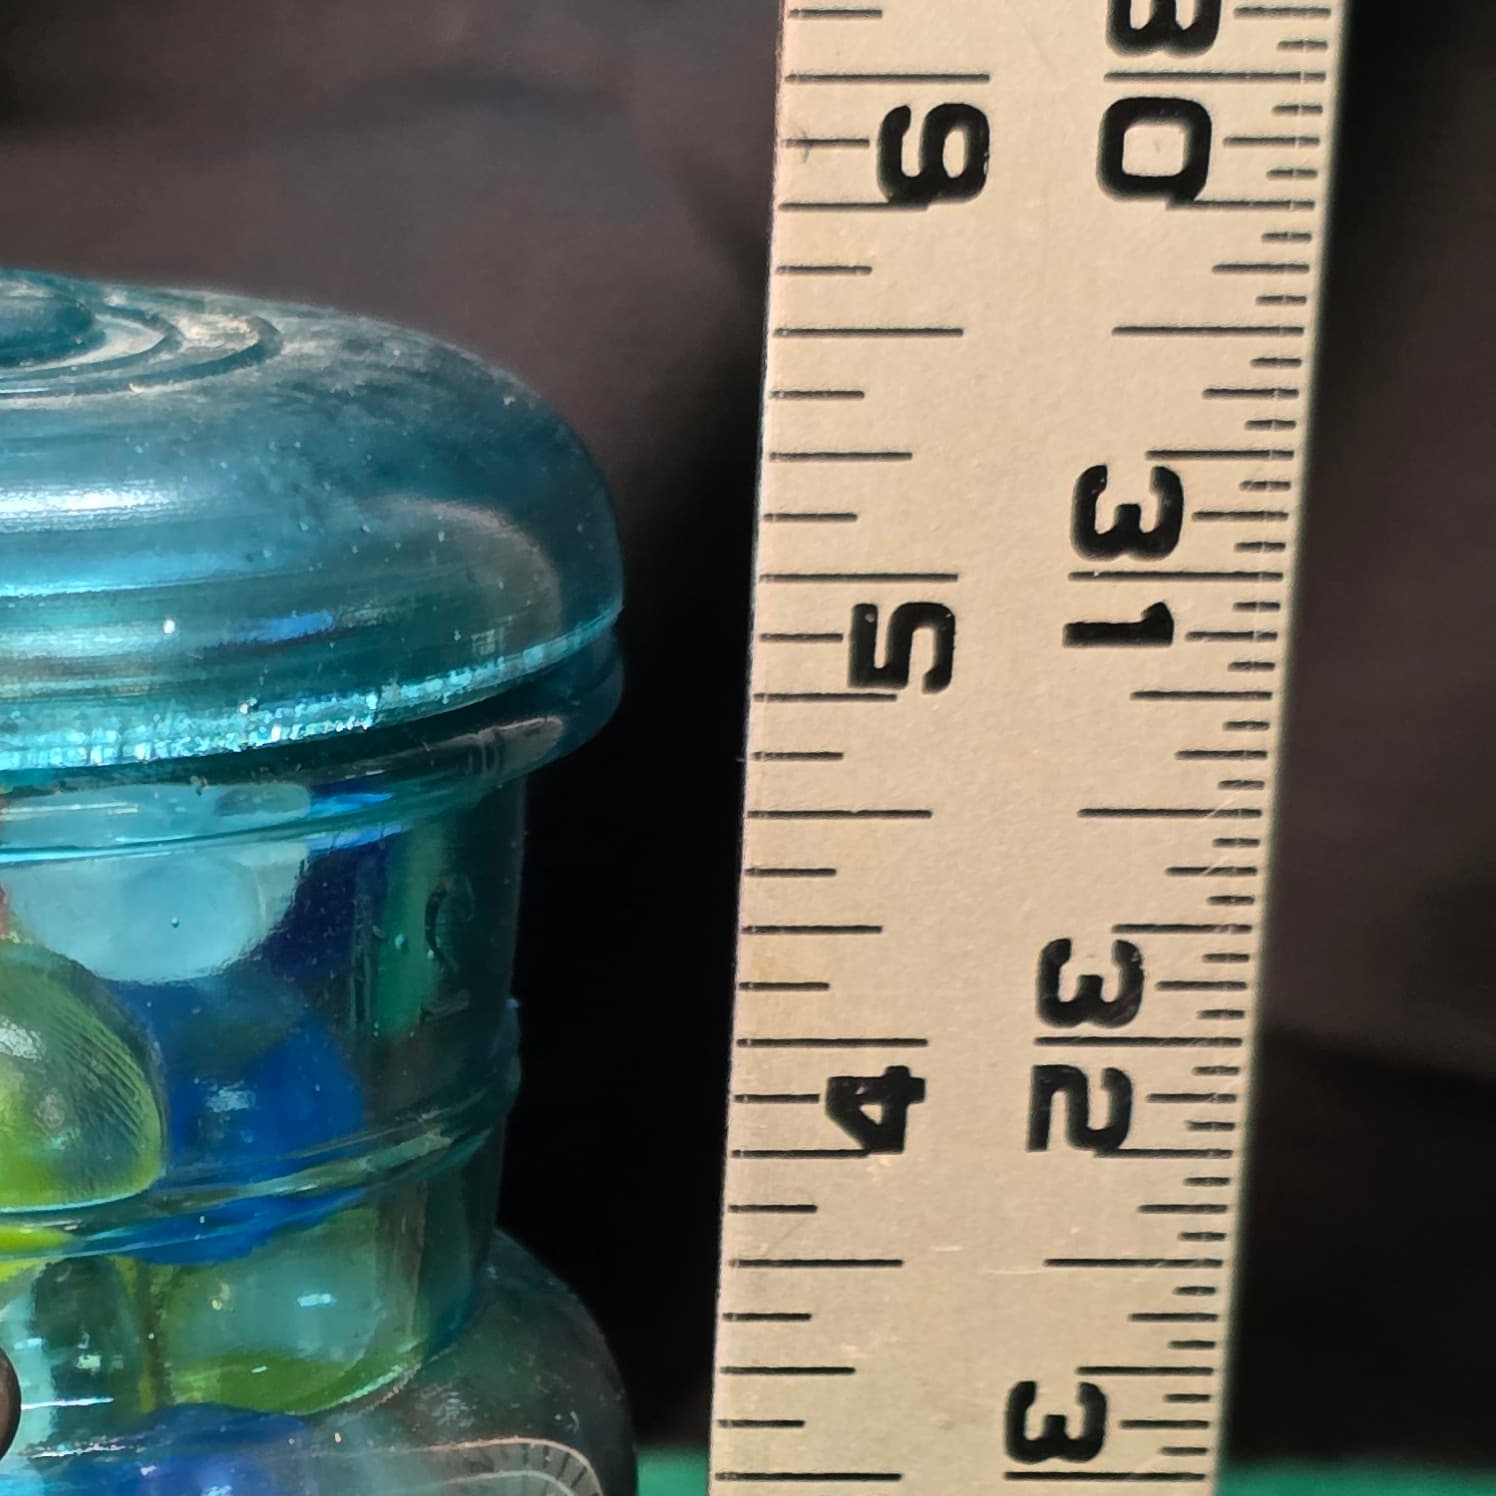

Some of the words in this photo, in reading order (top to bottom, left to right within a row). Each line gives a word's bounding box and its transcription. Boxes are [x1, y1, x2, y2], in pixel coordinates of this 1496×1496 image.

[876, 102, 991, 204] 6
[1062, 464, 1185, 649] 31
[847, 601, 957, 694] 5
[1025, 937, 1146, 1153] 32
[825, 1065, 926, 1155] 4
